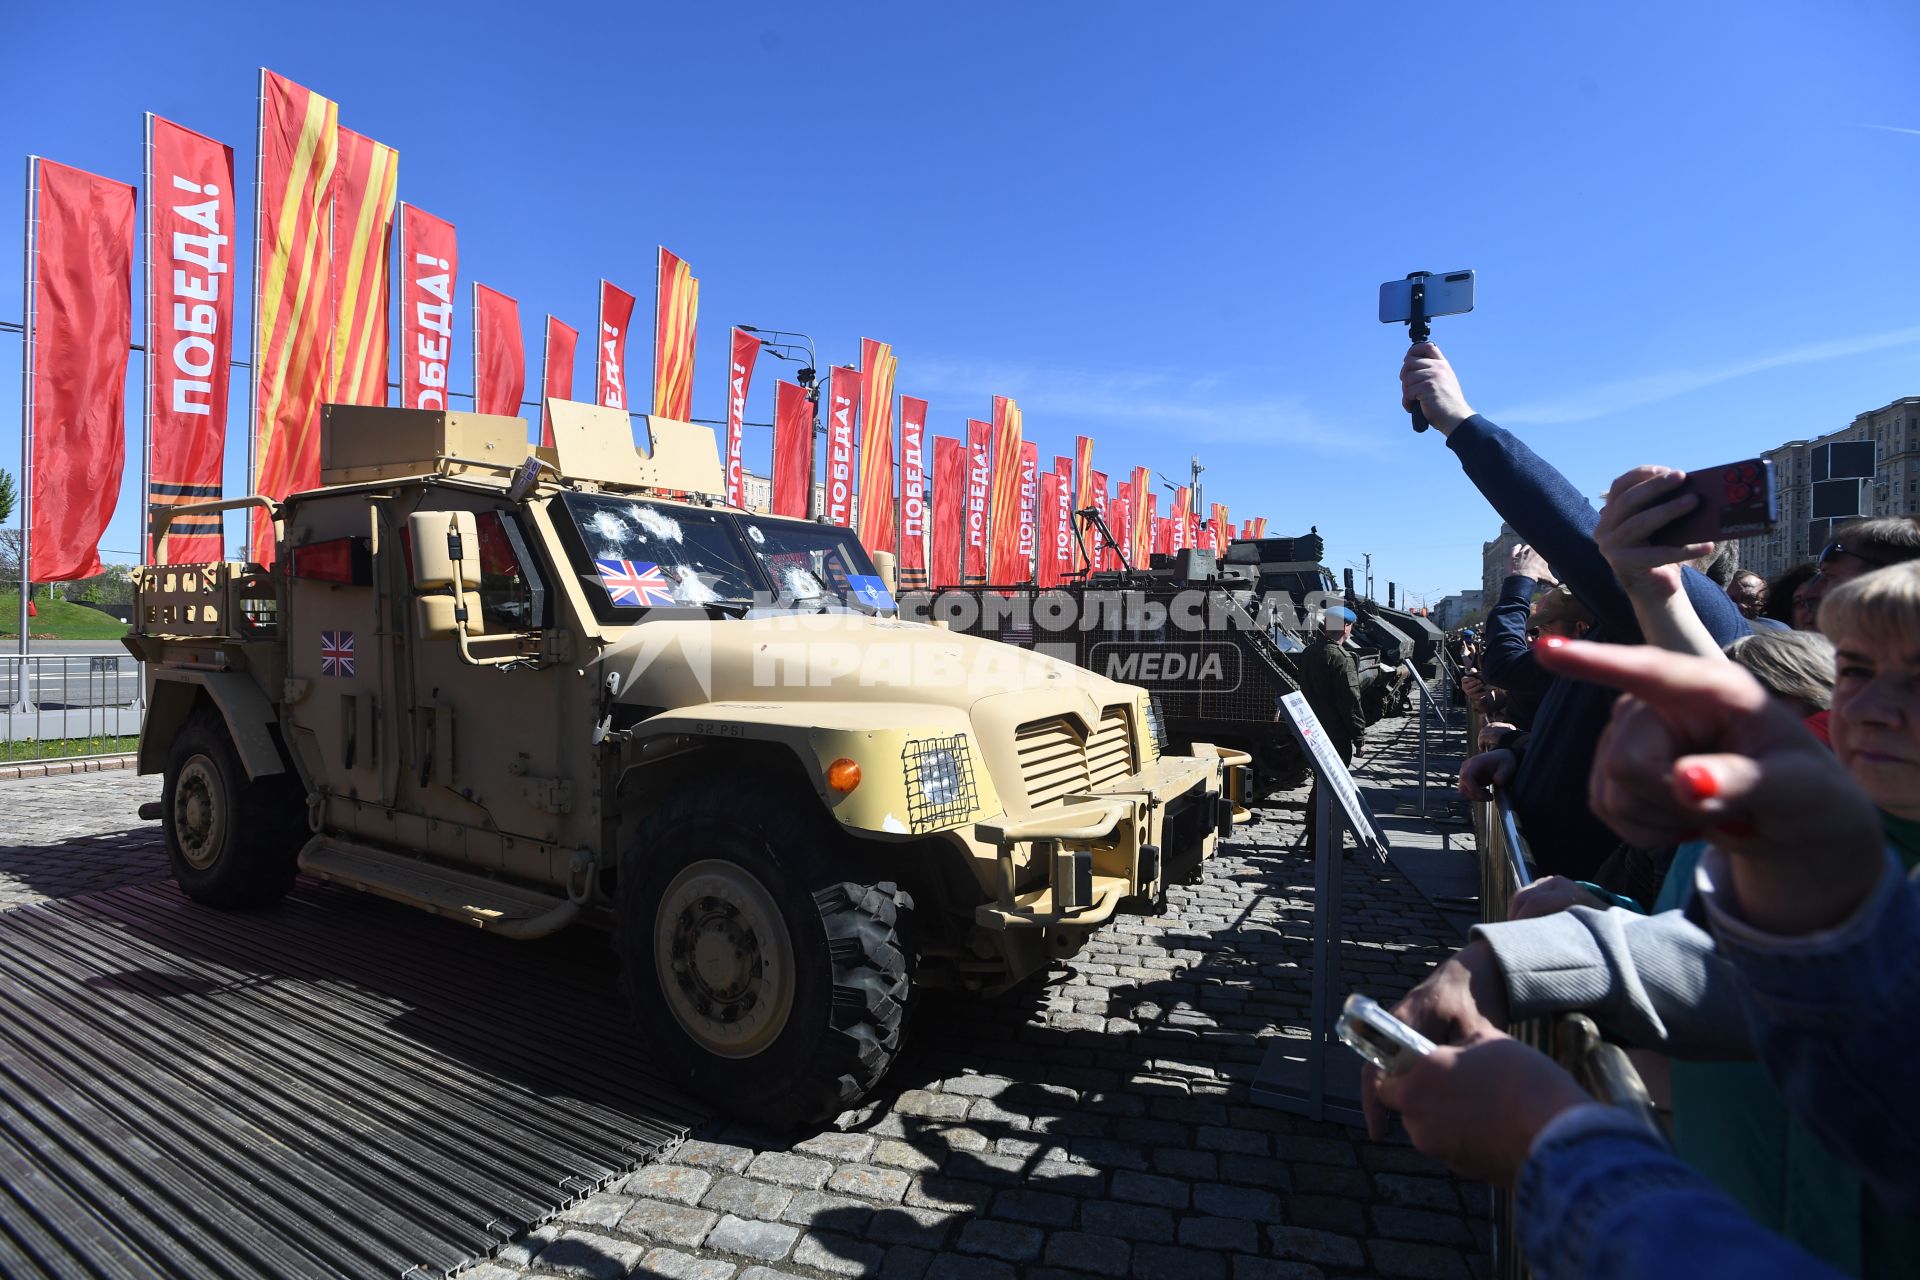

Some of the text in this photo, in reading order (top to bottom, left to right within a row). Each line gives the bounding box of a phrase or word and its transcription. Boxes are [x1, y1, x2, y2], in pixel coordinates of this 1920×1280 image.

[173, 174, 228, 416] ПОБЕДА!
[416, 252, 453, 410] ОБЕДА!
[603, 320, 622, 410] ЕДА!
[830, 395, 851, 524] ПОБЕДА!
[905, 422, 924, 536] ПОБЕДА!
[970, 443, 989, 547] ПОБЕДА!
[1019, 460, 1036, 556] ПОБЕДА!
[720, 725, 745, 736] PSI
